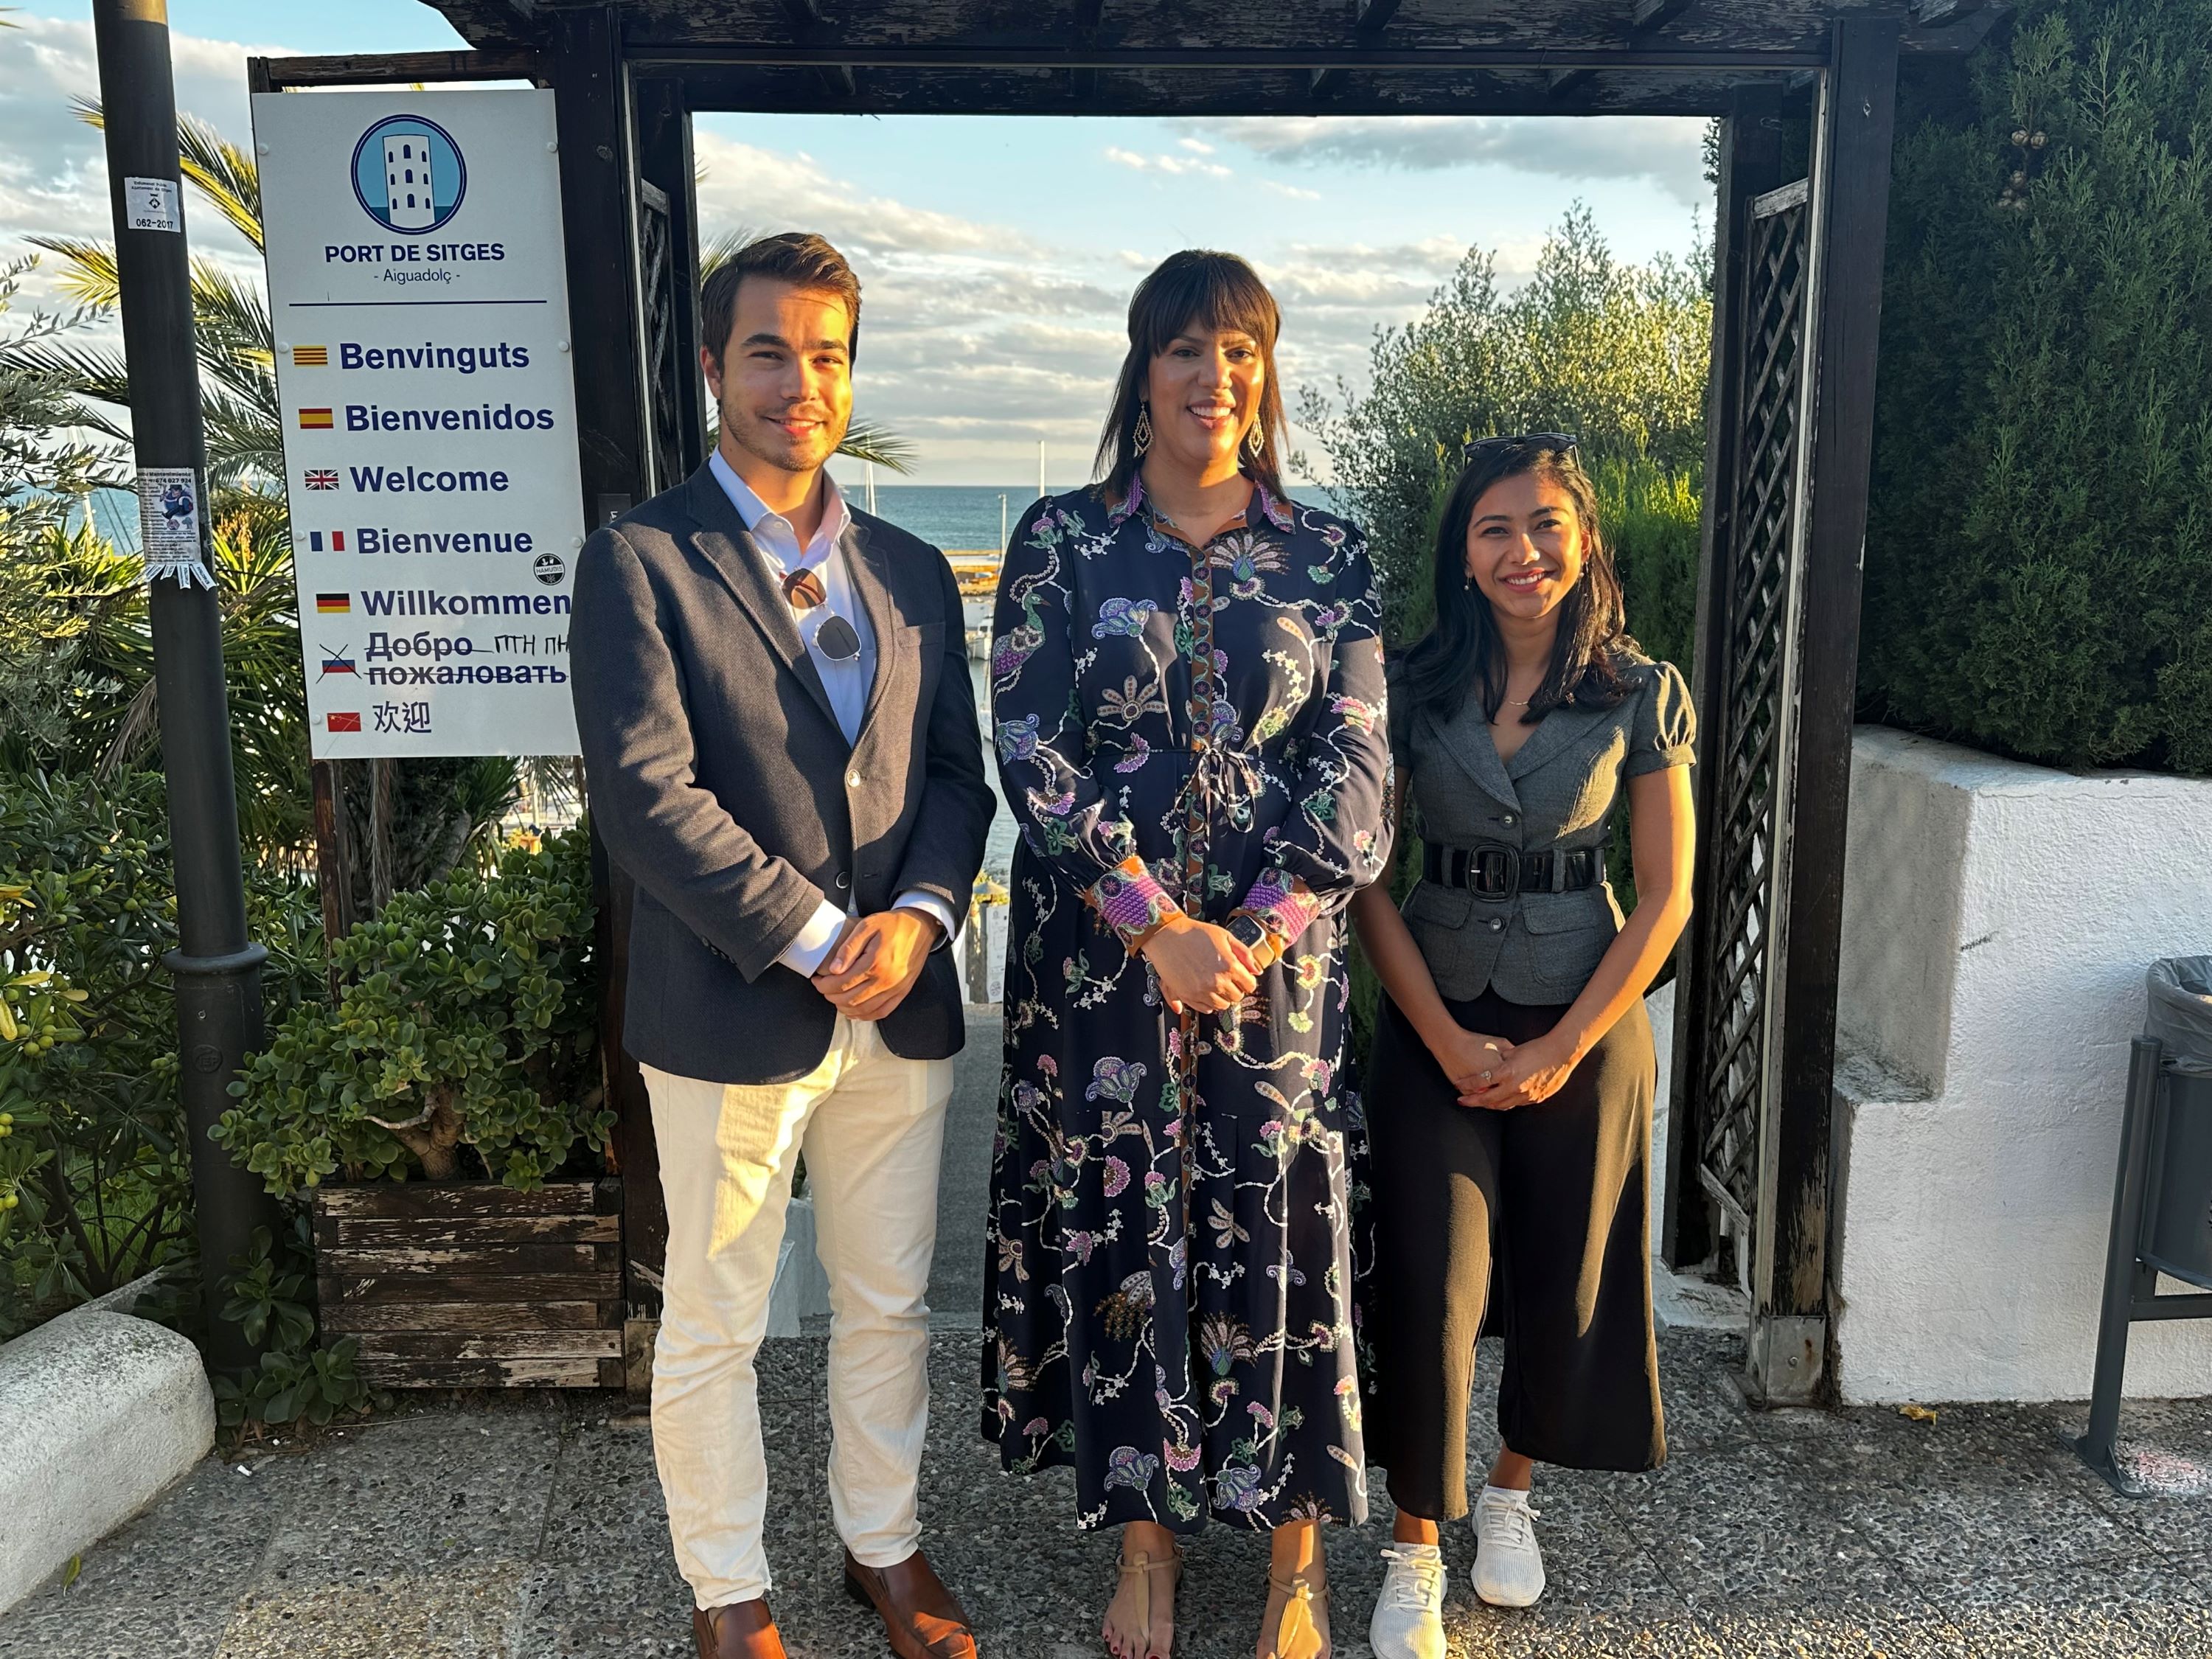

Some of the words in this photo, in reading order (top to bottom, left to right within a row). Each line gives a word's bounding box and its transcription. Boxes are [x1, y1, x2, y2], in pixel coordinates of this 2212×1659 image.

[136, 218, 174, 229] 062-2017
[325, 245, 384, 262] PORT
[391, 244, 420, 262] DE
[427, 243, 505, 261] SITGES
[383, 268, 451, 285] Aiguadolç
[340, 342, 530, 374] Benvinguts
[346, 403, 554, 431] Bienvenidos
[349, 466, 509, 493] Welcome
[357, 528, 533, 554] Bienvenue
[536, 566, 563, 574] HAMUDIS
[361, 590, 571, 616] Willkommen
[366, 631, 473, 662] Добро
[368, 665, 567, 686] пожаловать
[372, 700, 432, 734] 欢迎
